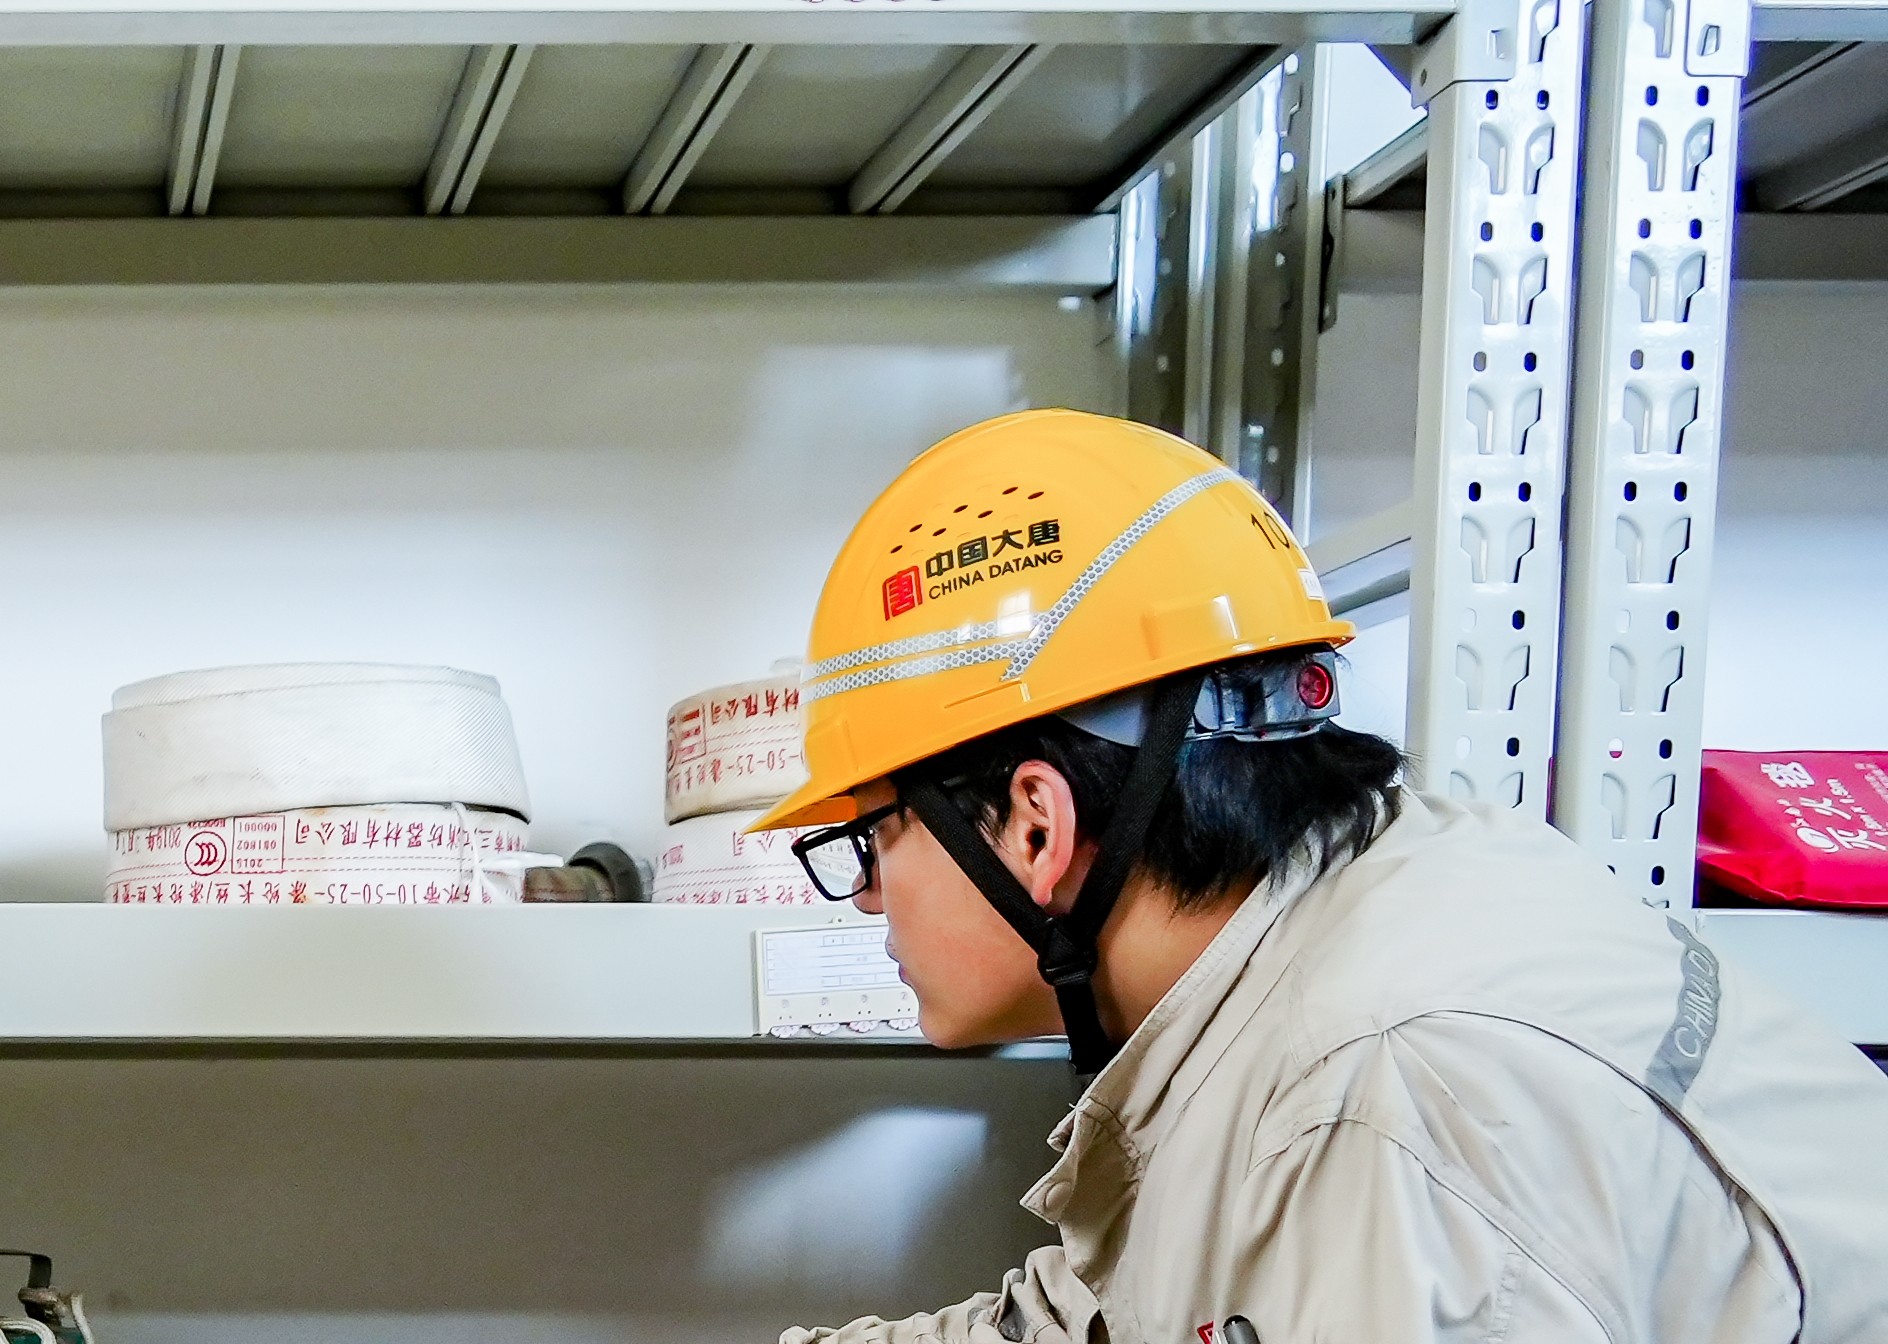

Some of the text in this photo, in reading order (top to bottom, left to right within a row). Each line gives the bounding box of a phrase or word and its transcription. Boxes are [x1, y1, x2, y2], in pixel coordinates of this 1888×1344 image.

[926, 519, 1060, 579] 中国大唐
[928, 549, 1064, 600] CHINA DATANG
